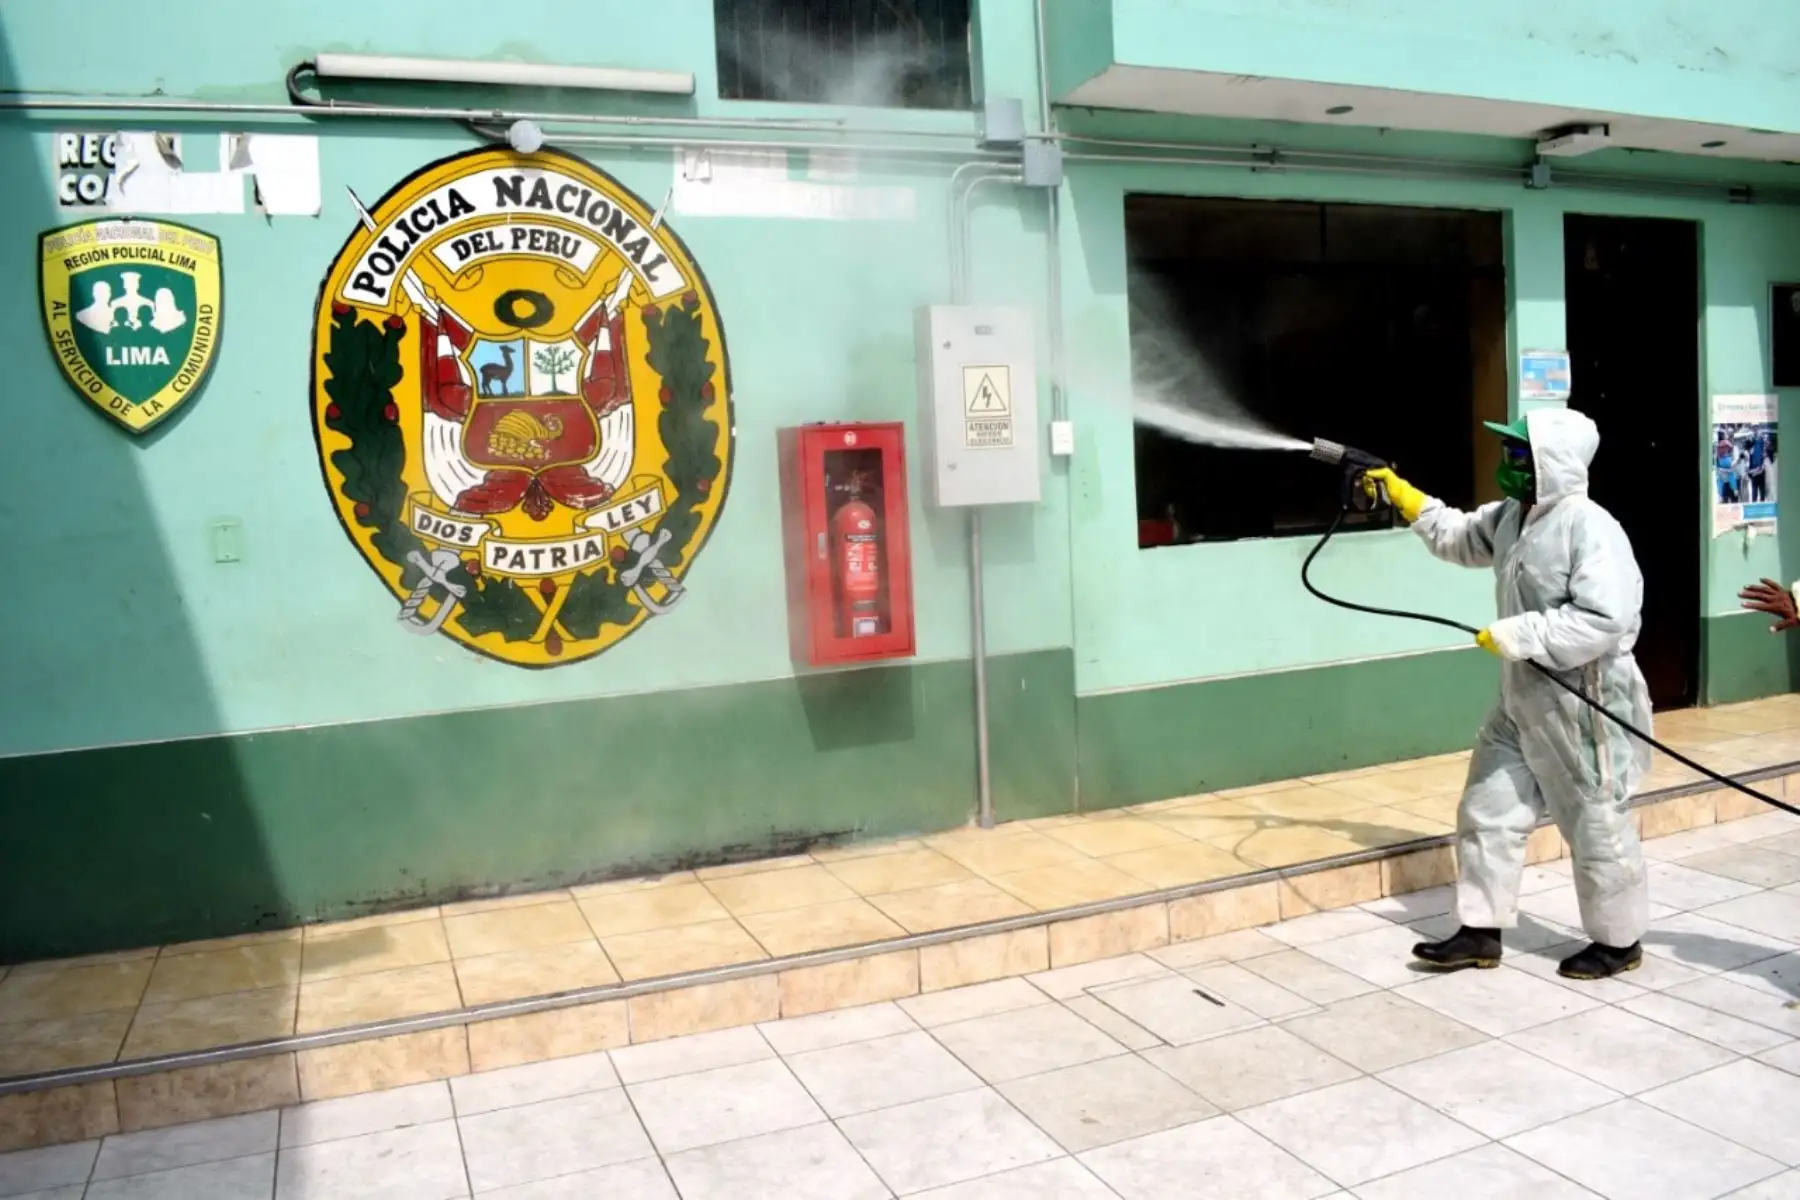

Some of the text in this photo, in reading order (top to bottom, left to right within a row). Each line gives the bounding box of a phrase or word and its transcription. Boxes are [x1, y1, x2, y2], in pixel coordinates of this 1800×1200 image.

[64, 247, 197, 272] REGION POLICIAL LIMA
[352, 175, 669, 299] POLICIA NACIONAL
[451, 228, 582, 261] DEL PERU
[51, 300, 213, 417] AL SERVICIO DE LA COMUNIDAD
[105, 346, 170, 366] LIMA
[417, 495, 653, 569] DIOS PATRIA LEY
